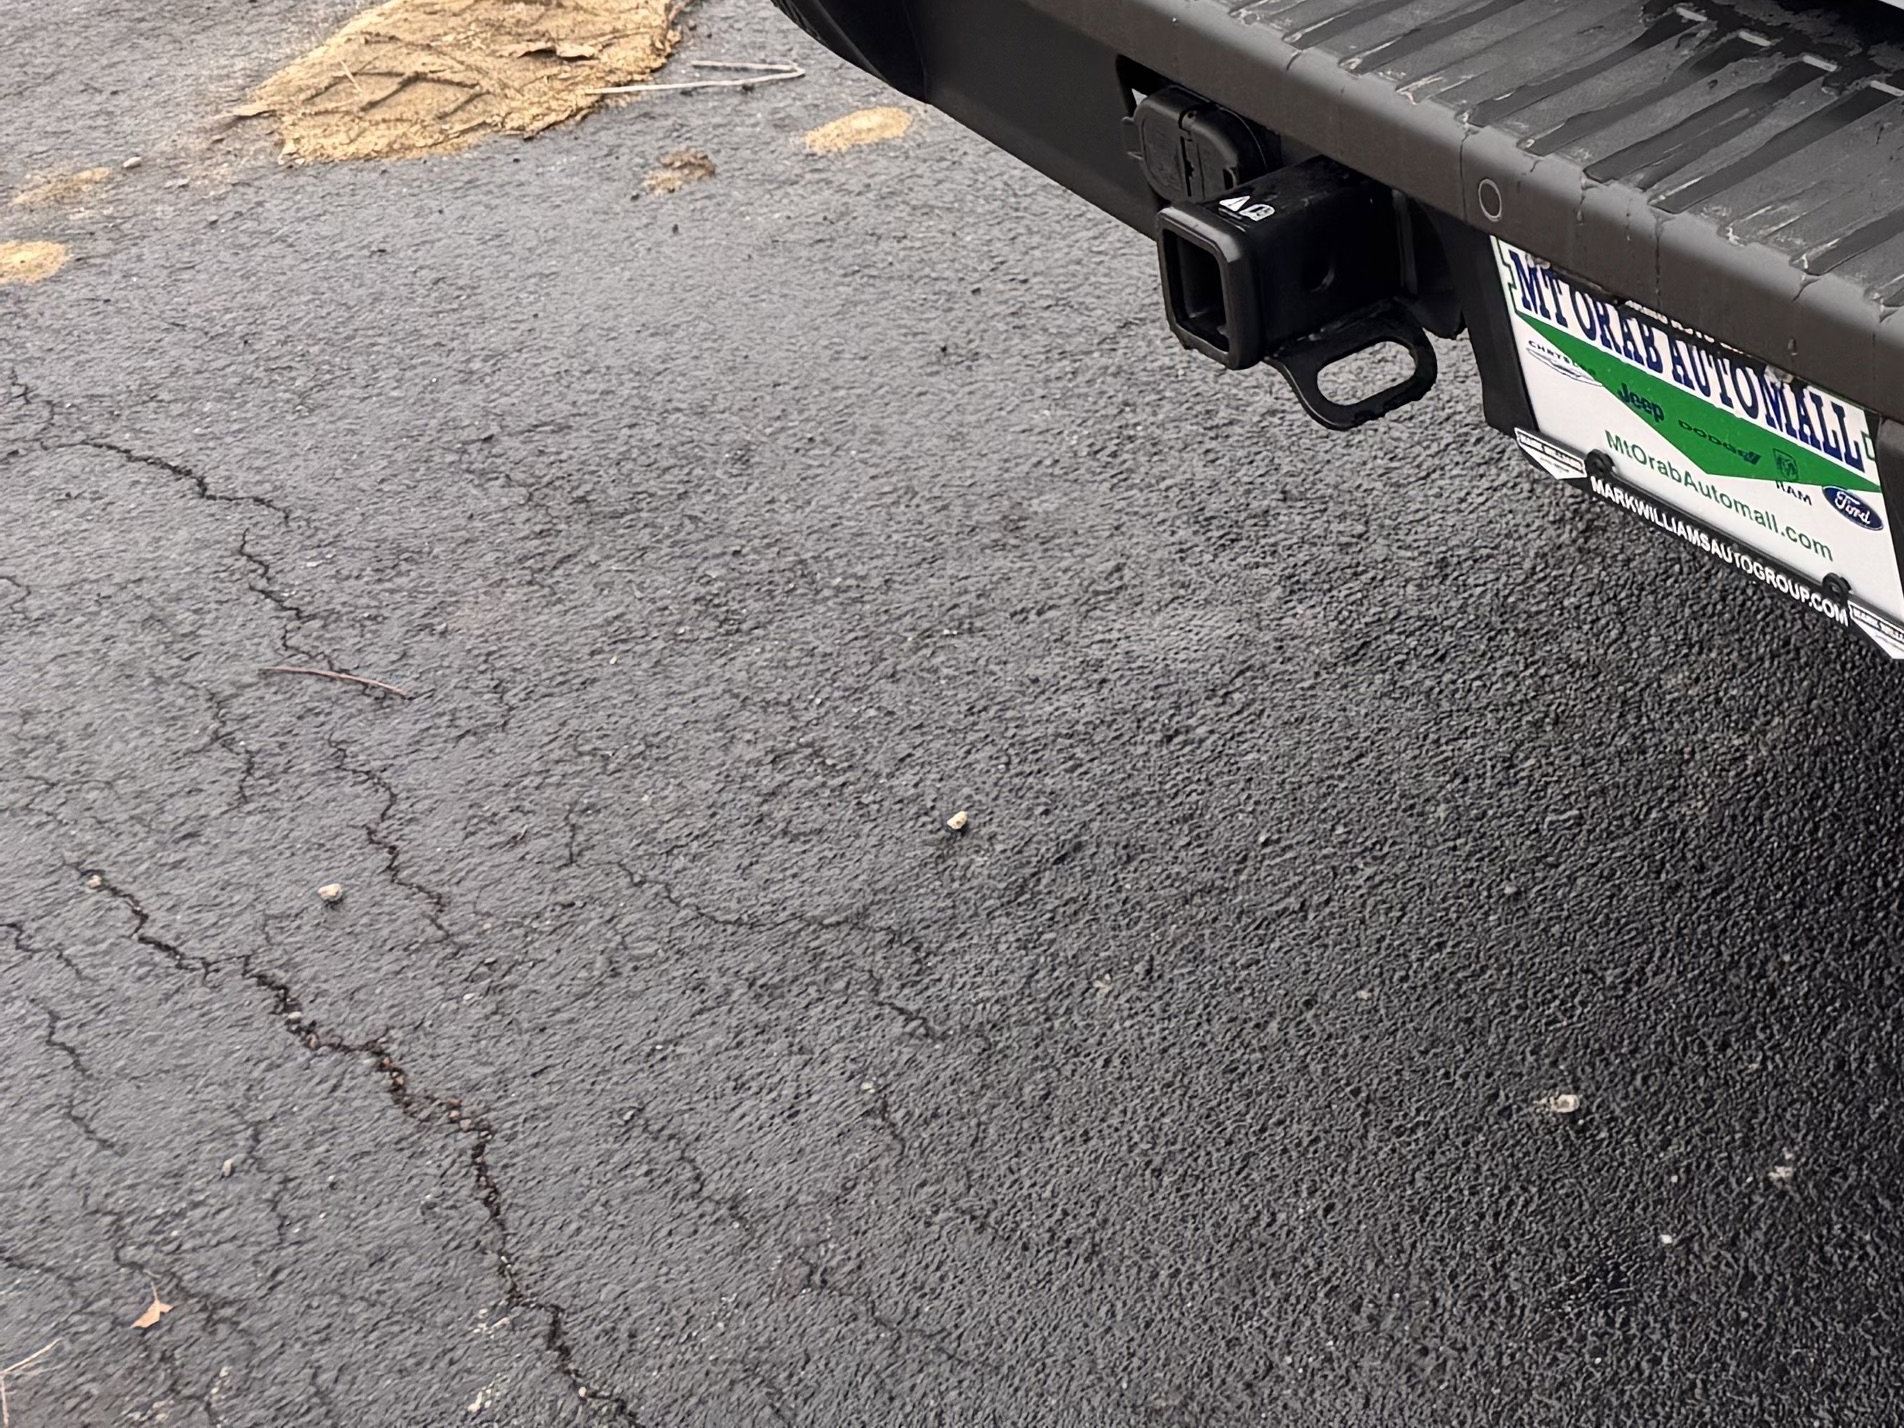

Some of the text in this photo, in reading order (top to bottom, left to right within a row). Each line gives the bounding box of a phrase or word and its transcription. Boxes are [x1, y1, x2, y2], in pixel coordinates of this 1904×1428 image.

[1508, 249, 1569, 329] MT
[1573, 290, 1664, 374] ORAB
[1668, 336, 1866, 474] AUTOMALL
[1616, 383, 1666, 422] Jeep
[1590, 475, 1849, 627] MARKWILLIAMSAUTOGROUP.COM
[1605, 429, 1834, 562] MtOrabAutomall.com
